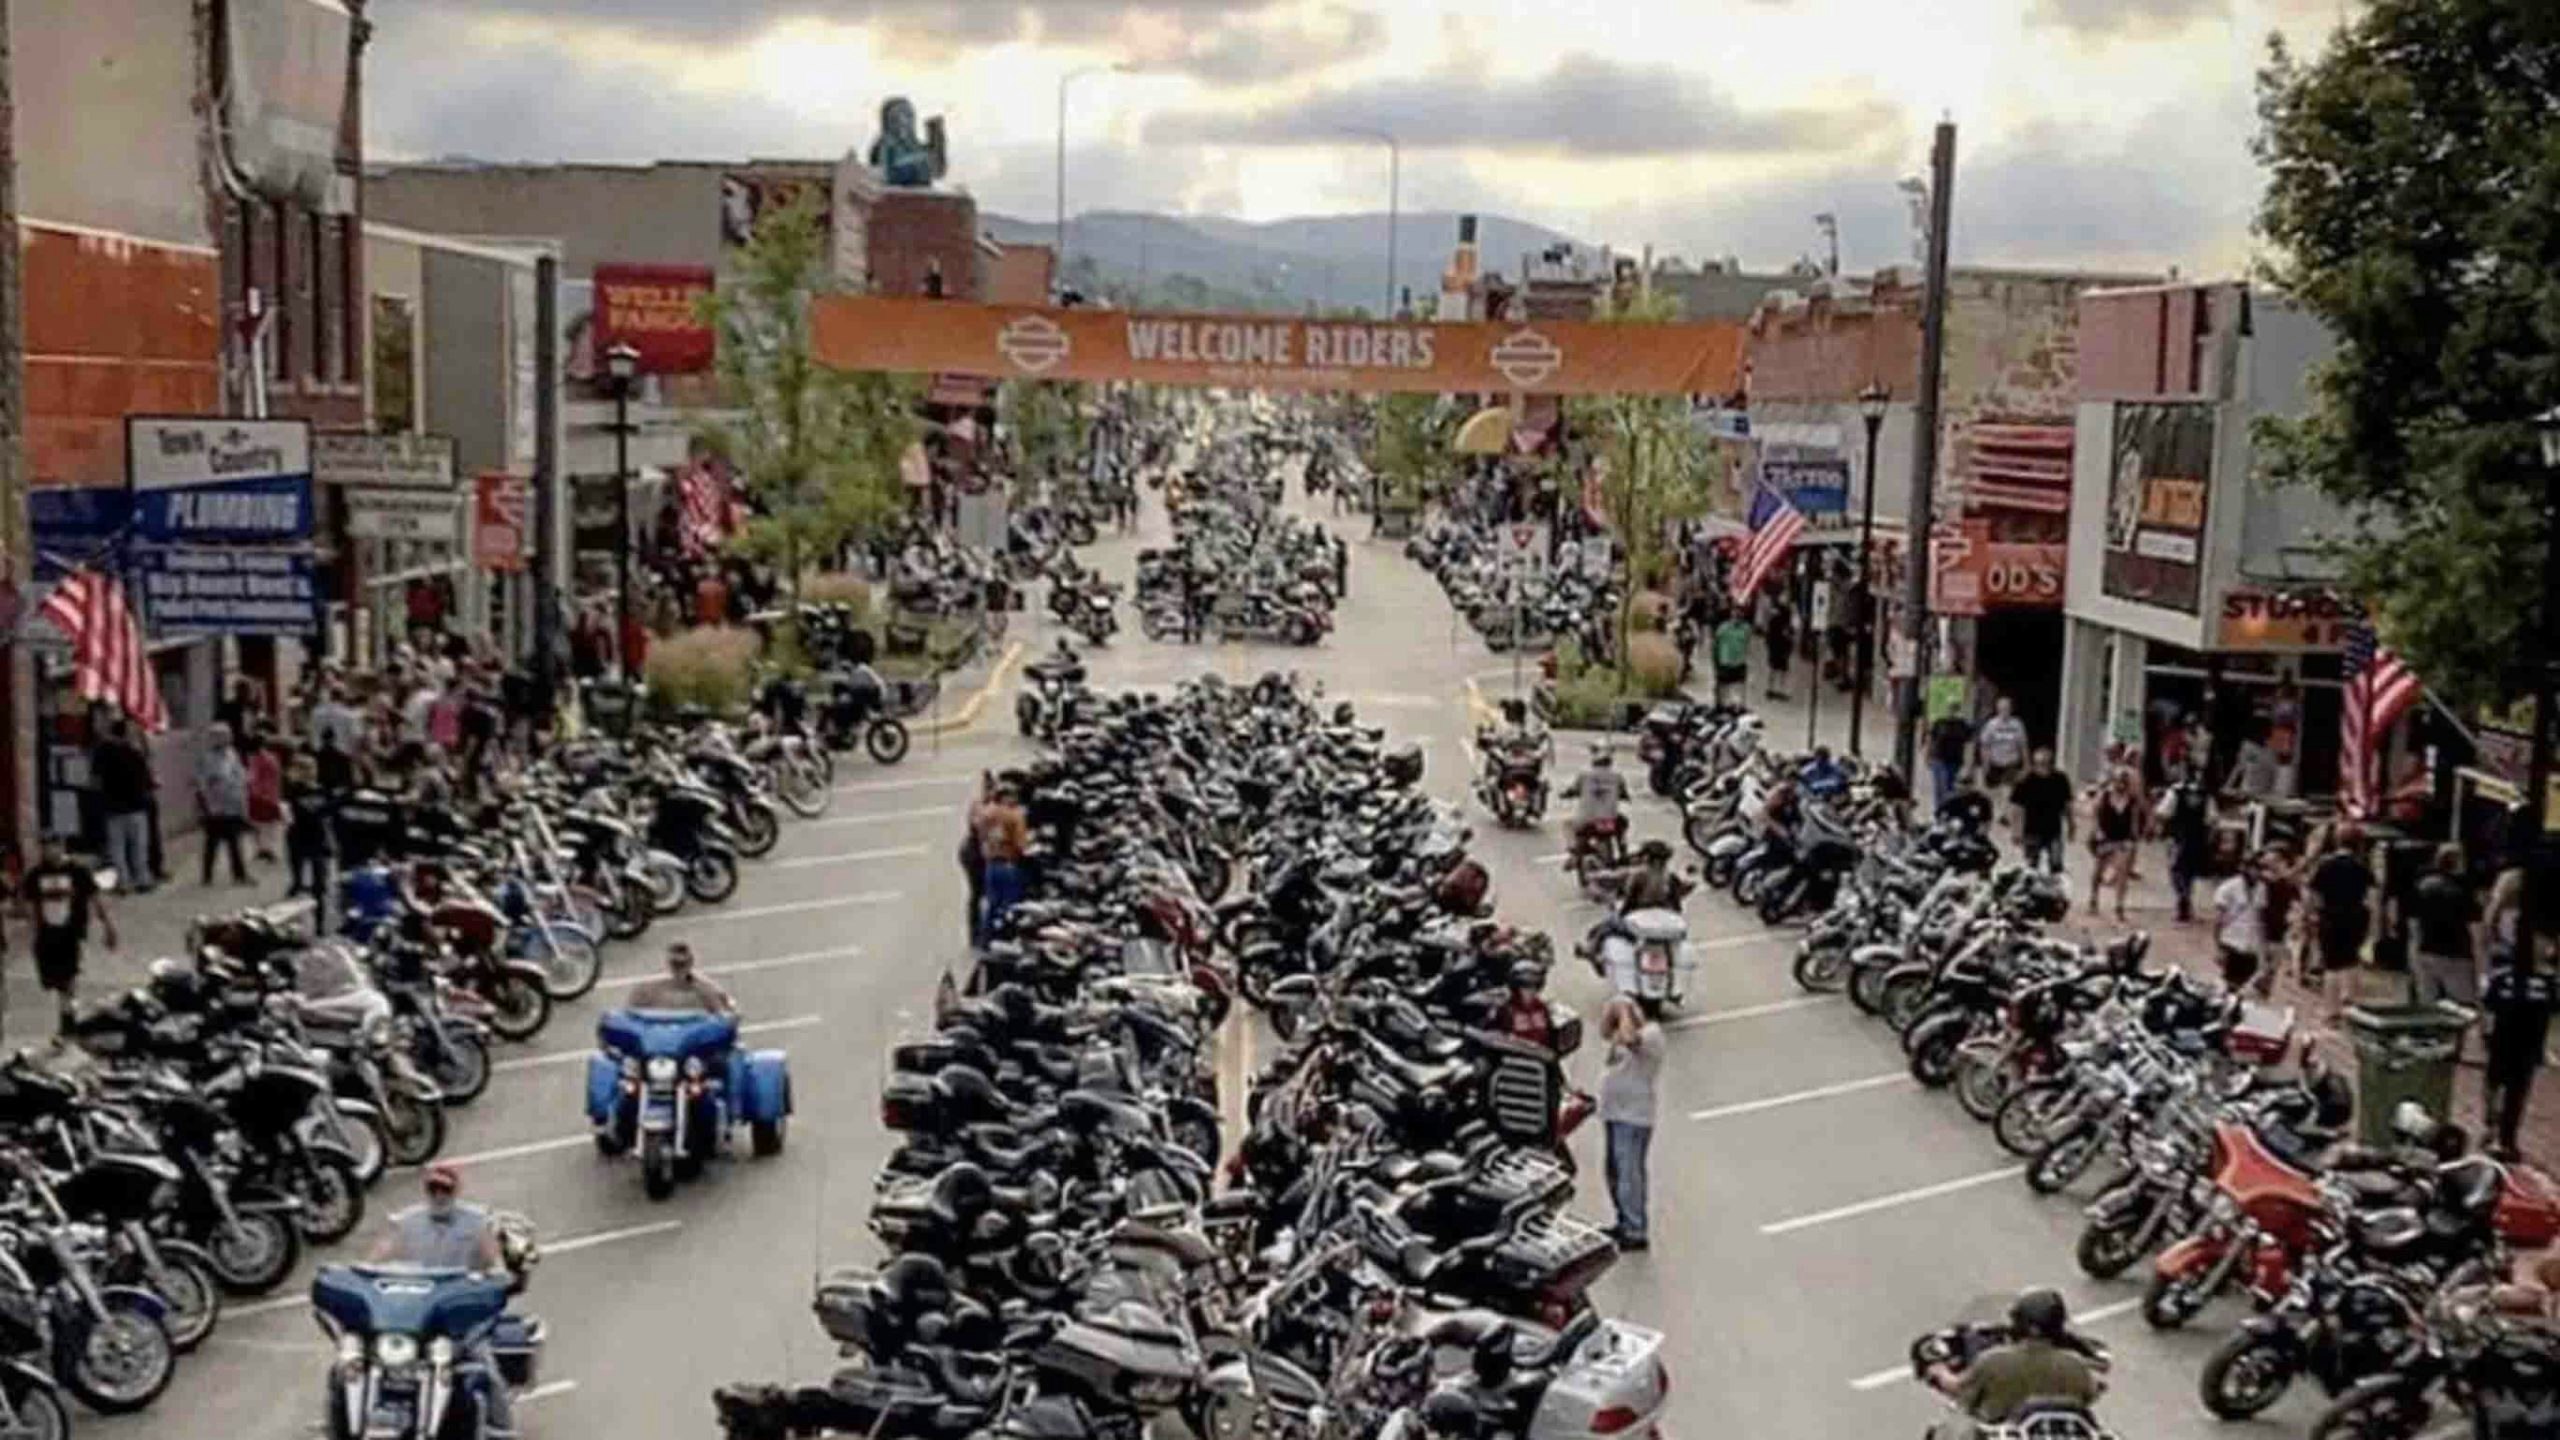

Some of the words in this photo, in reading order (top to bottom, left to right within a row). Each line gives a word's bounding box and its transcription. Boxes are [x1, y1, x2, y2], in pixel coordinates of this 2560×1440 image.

[1126, 319, 1293, 364] WELCOME
[1305, 323, 1436, 368] RIDERS
[165, 493, 298, 530] PLUMBING
